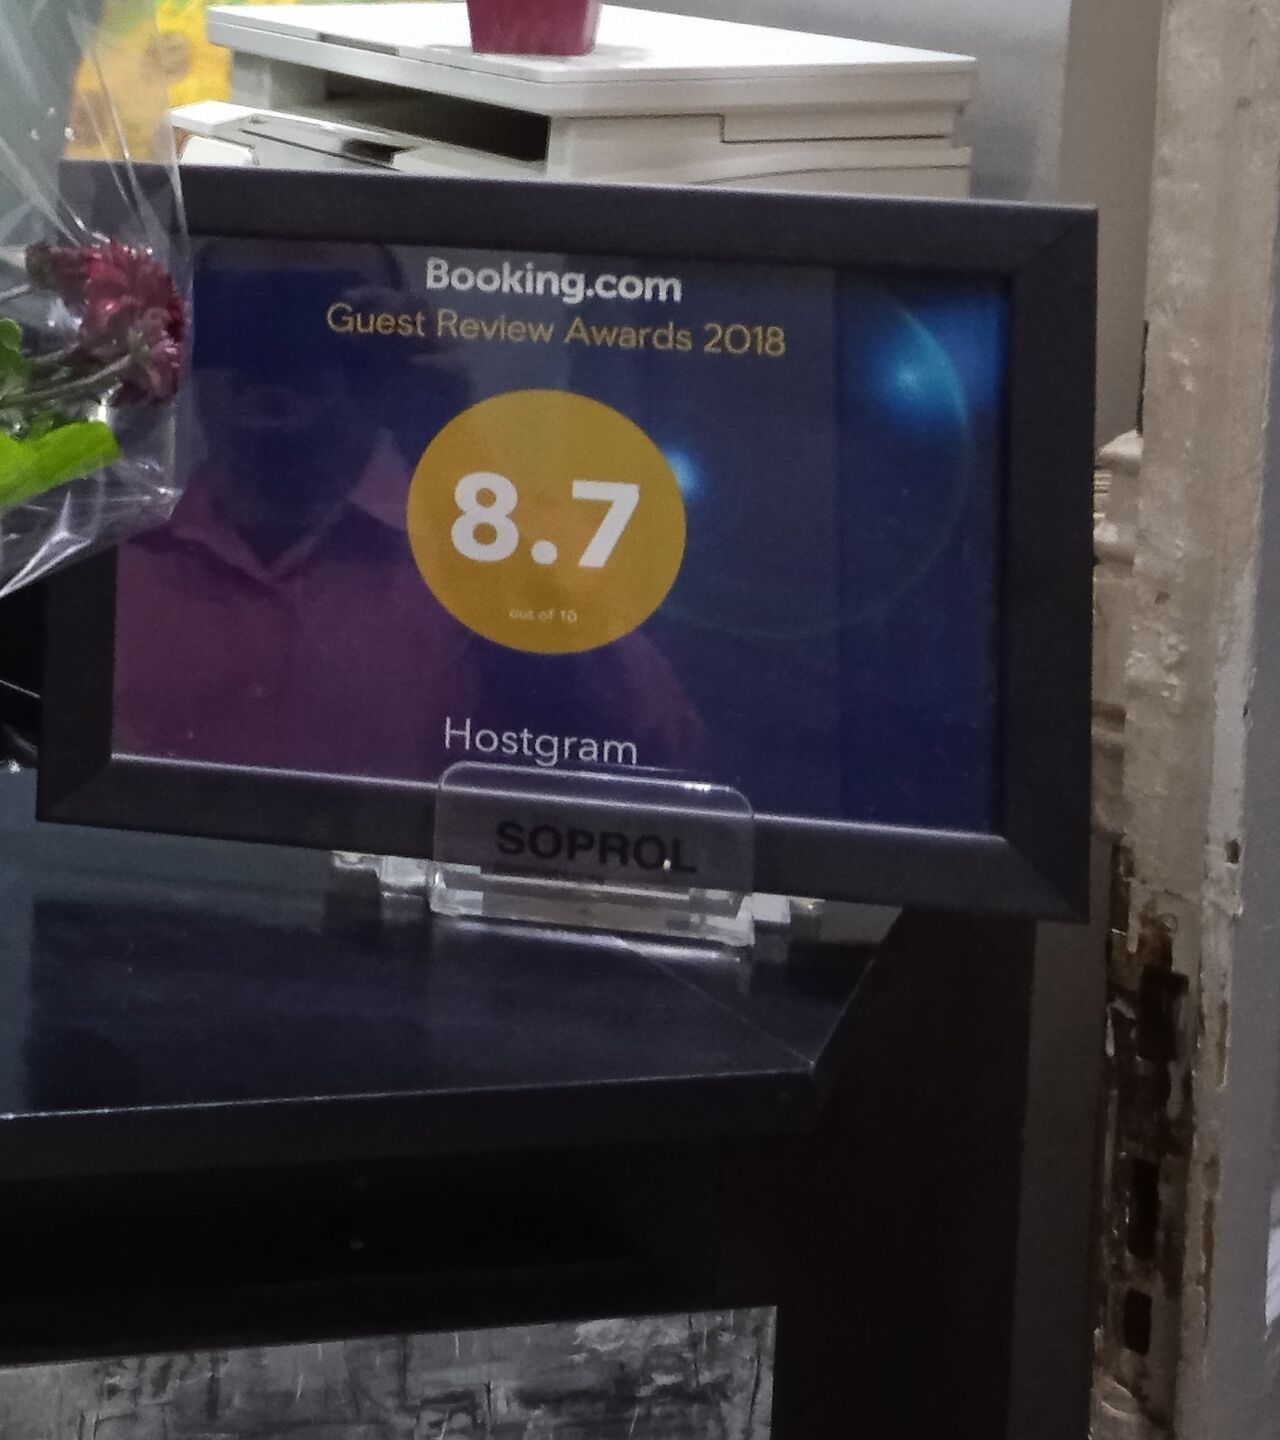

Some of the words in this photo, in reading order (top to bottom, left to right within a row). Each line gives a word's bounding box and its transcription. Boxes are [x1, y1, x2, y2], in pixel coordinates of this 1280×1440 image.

[425, 258, 683, 303] Booking.com
[326, 302, 426, 336] Guest
[437, 308, 554, 344] Review
[564, 316, 693, 352] Awards
[704, 322, 787, 356] 2018
[450, 471, 641, 570] 8.7
[444, 716, 638, 767] Hostgram
[495, 820, 698, 875] SOPROL
